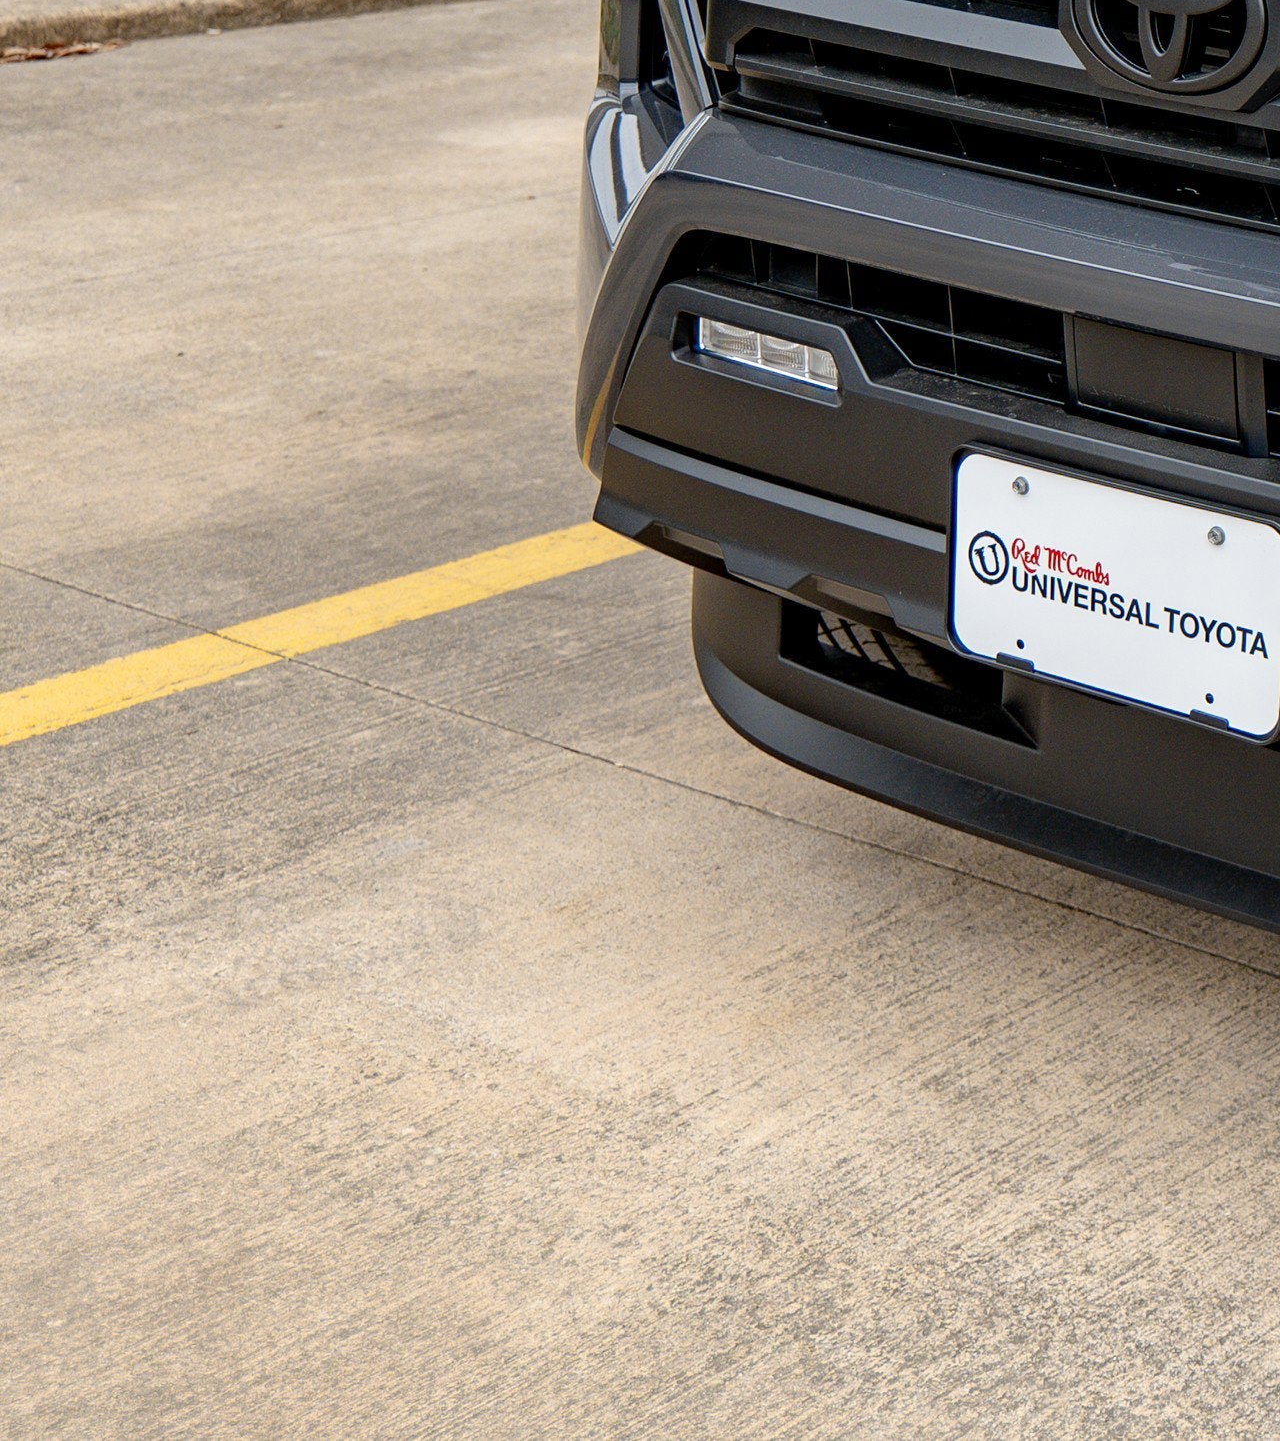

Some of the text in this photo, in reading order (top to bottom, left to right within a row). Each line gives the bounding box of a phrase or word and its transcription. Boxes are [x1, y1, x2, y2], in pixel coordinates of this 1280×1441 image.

[1011, 538, 1110, 586] Red McCombs
[1012, 566, 1269, 660] UNIVERSAL TOYOTA
